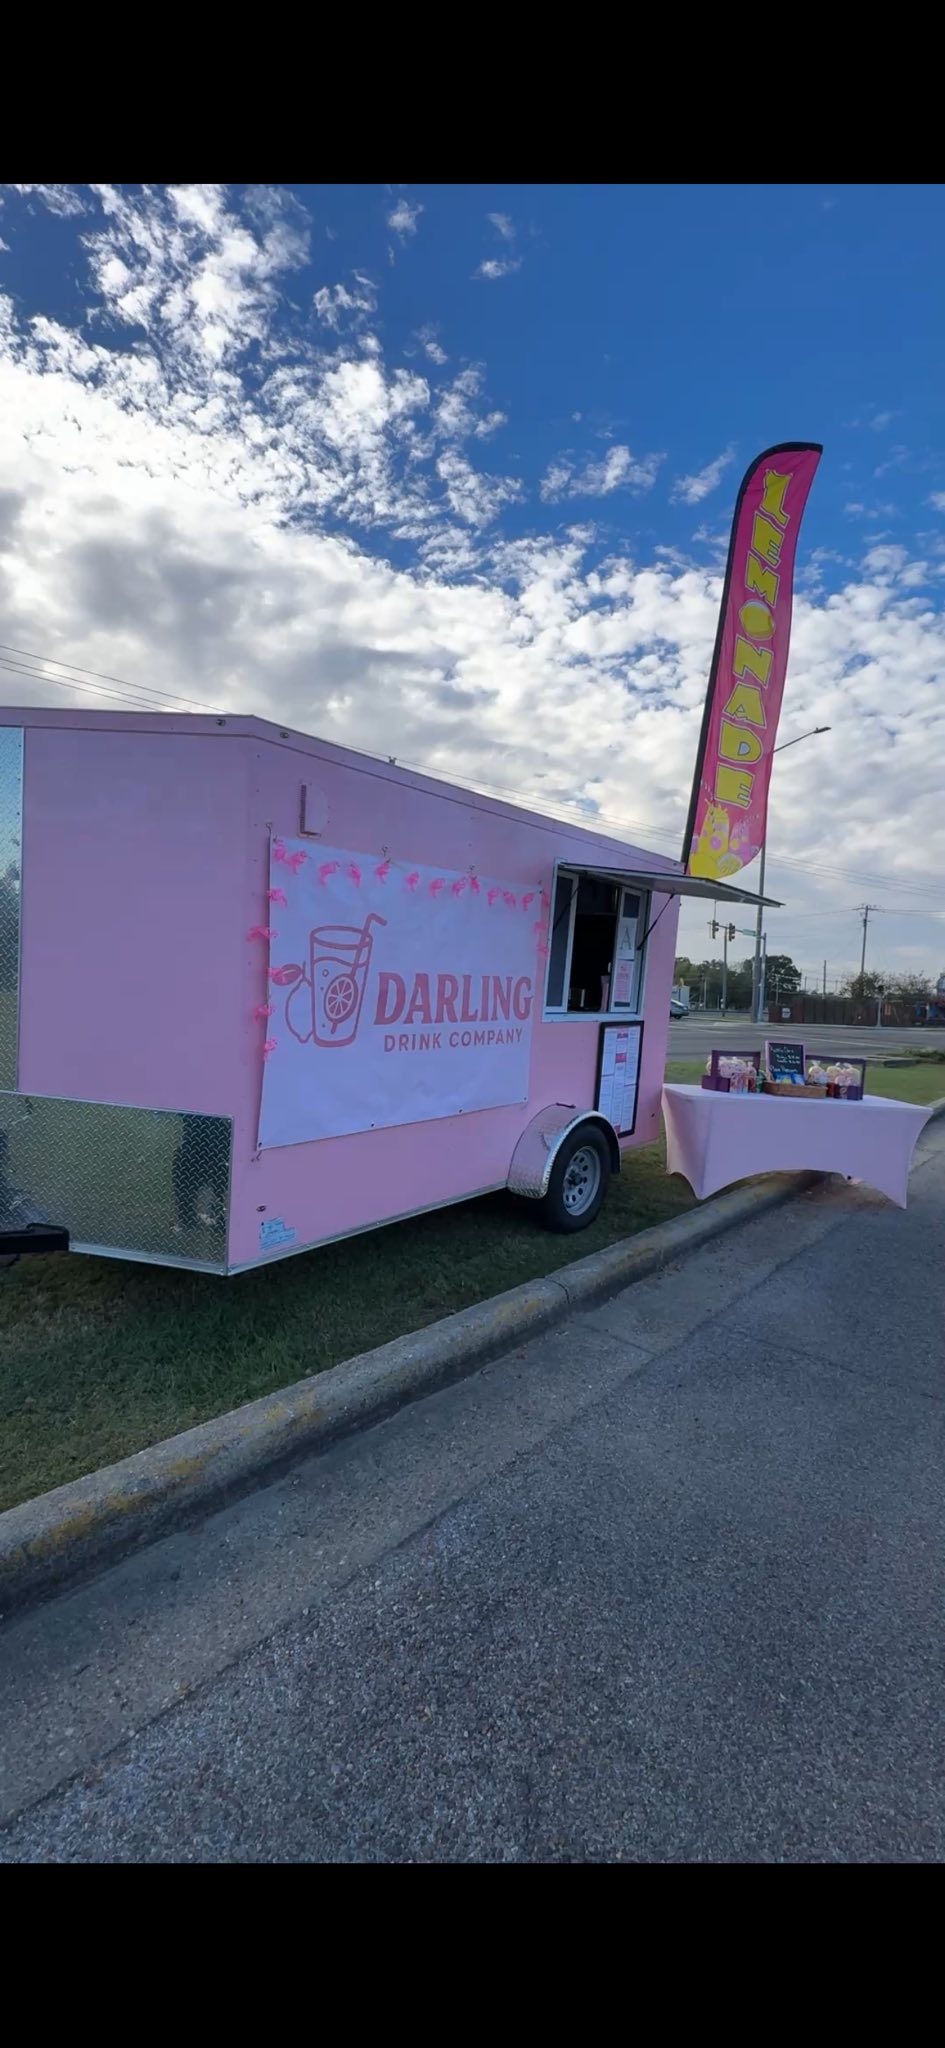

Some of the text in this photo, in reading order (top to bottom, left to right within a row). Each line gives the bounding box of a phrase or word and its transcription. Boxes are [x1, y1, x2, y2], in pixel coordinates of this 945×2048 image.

[715, 468, 793, 810] LEMONADE
[619, 927, 632, 950] A
[373, 971, 534, 1025] DARLING
[384, 1027, 524, 1052] DRINK COMPANY
